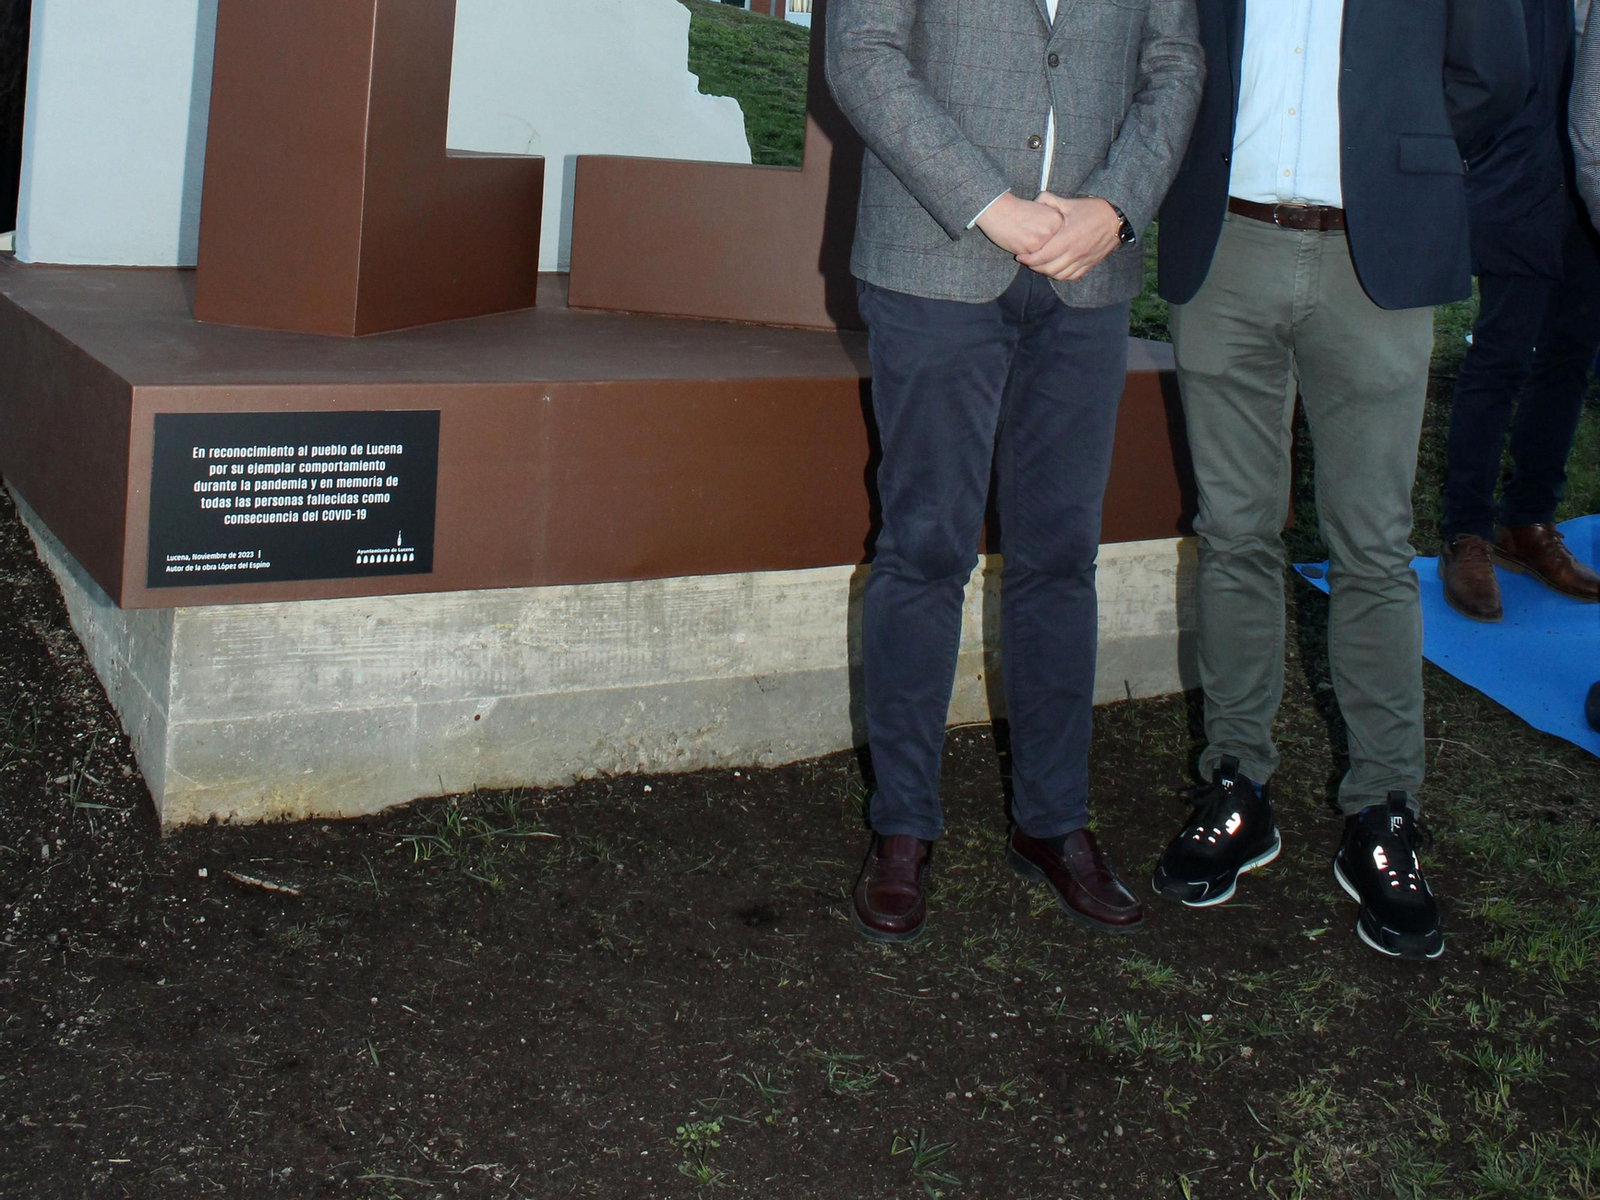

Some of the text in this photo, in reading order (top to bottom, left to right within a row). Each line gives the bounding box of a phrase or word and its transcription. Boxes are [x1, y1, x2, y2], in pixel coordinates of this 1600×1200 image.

[192, 444, 402, 458] En reconocimiento al pueblo de Lucena
[209, 460, 386, 476] por su ejemplar comportamiento
[194, 476, 398, 492] durante la pandemia y en memoria de
[201, 493, 390, 509] todas las personas fallecidas como
[224, 509, 367, 525] consecuencia del COVID-19
[167, 554, 190, 562] Lucena,
[218, 563, 236, 571] López
[249, 561, 270, 569] Espino
